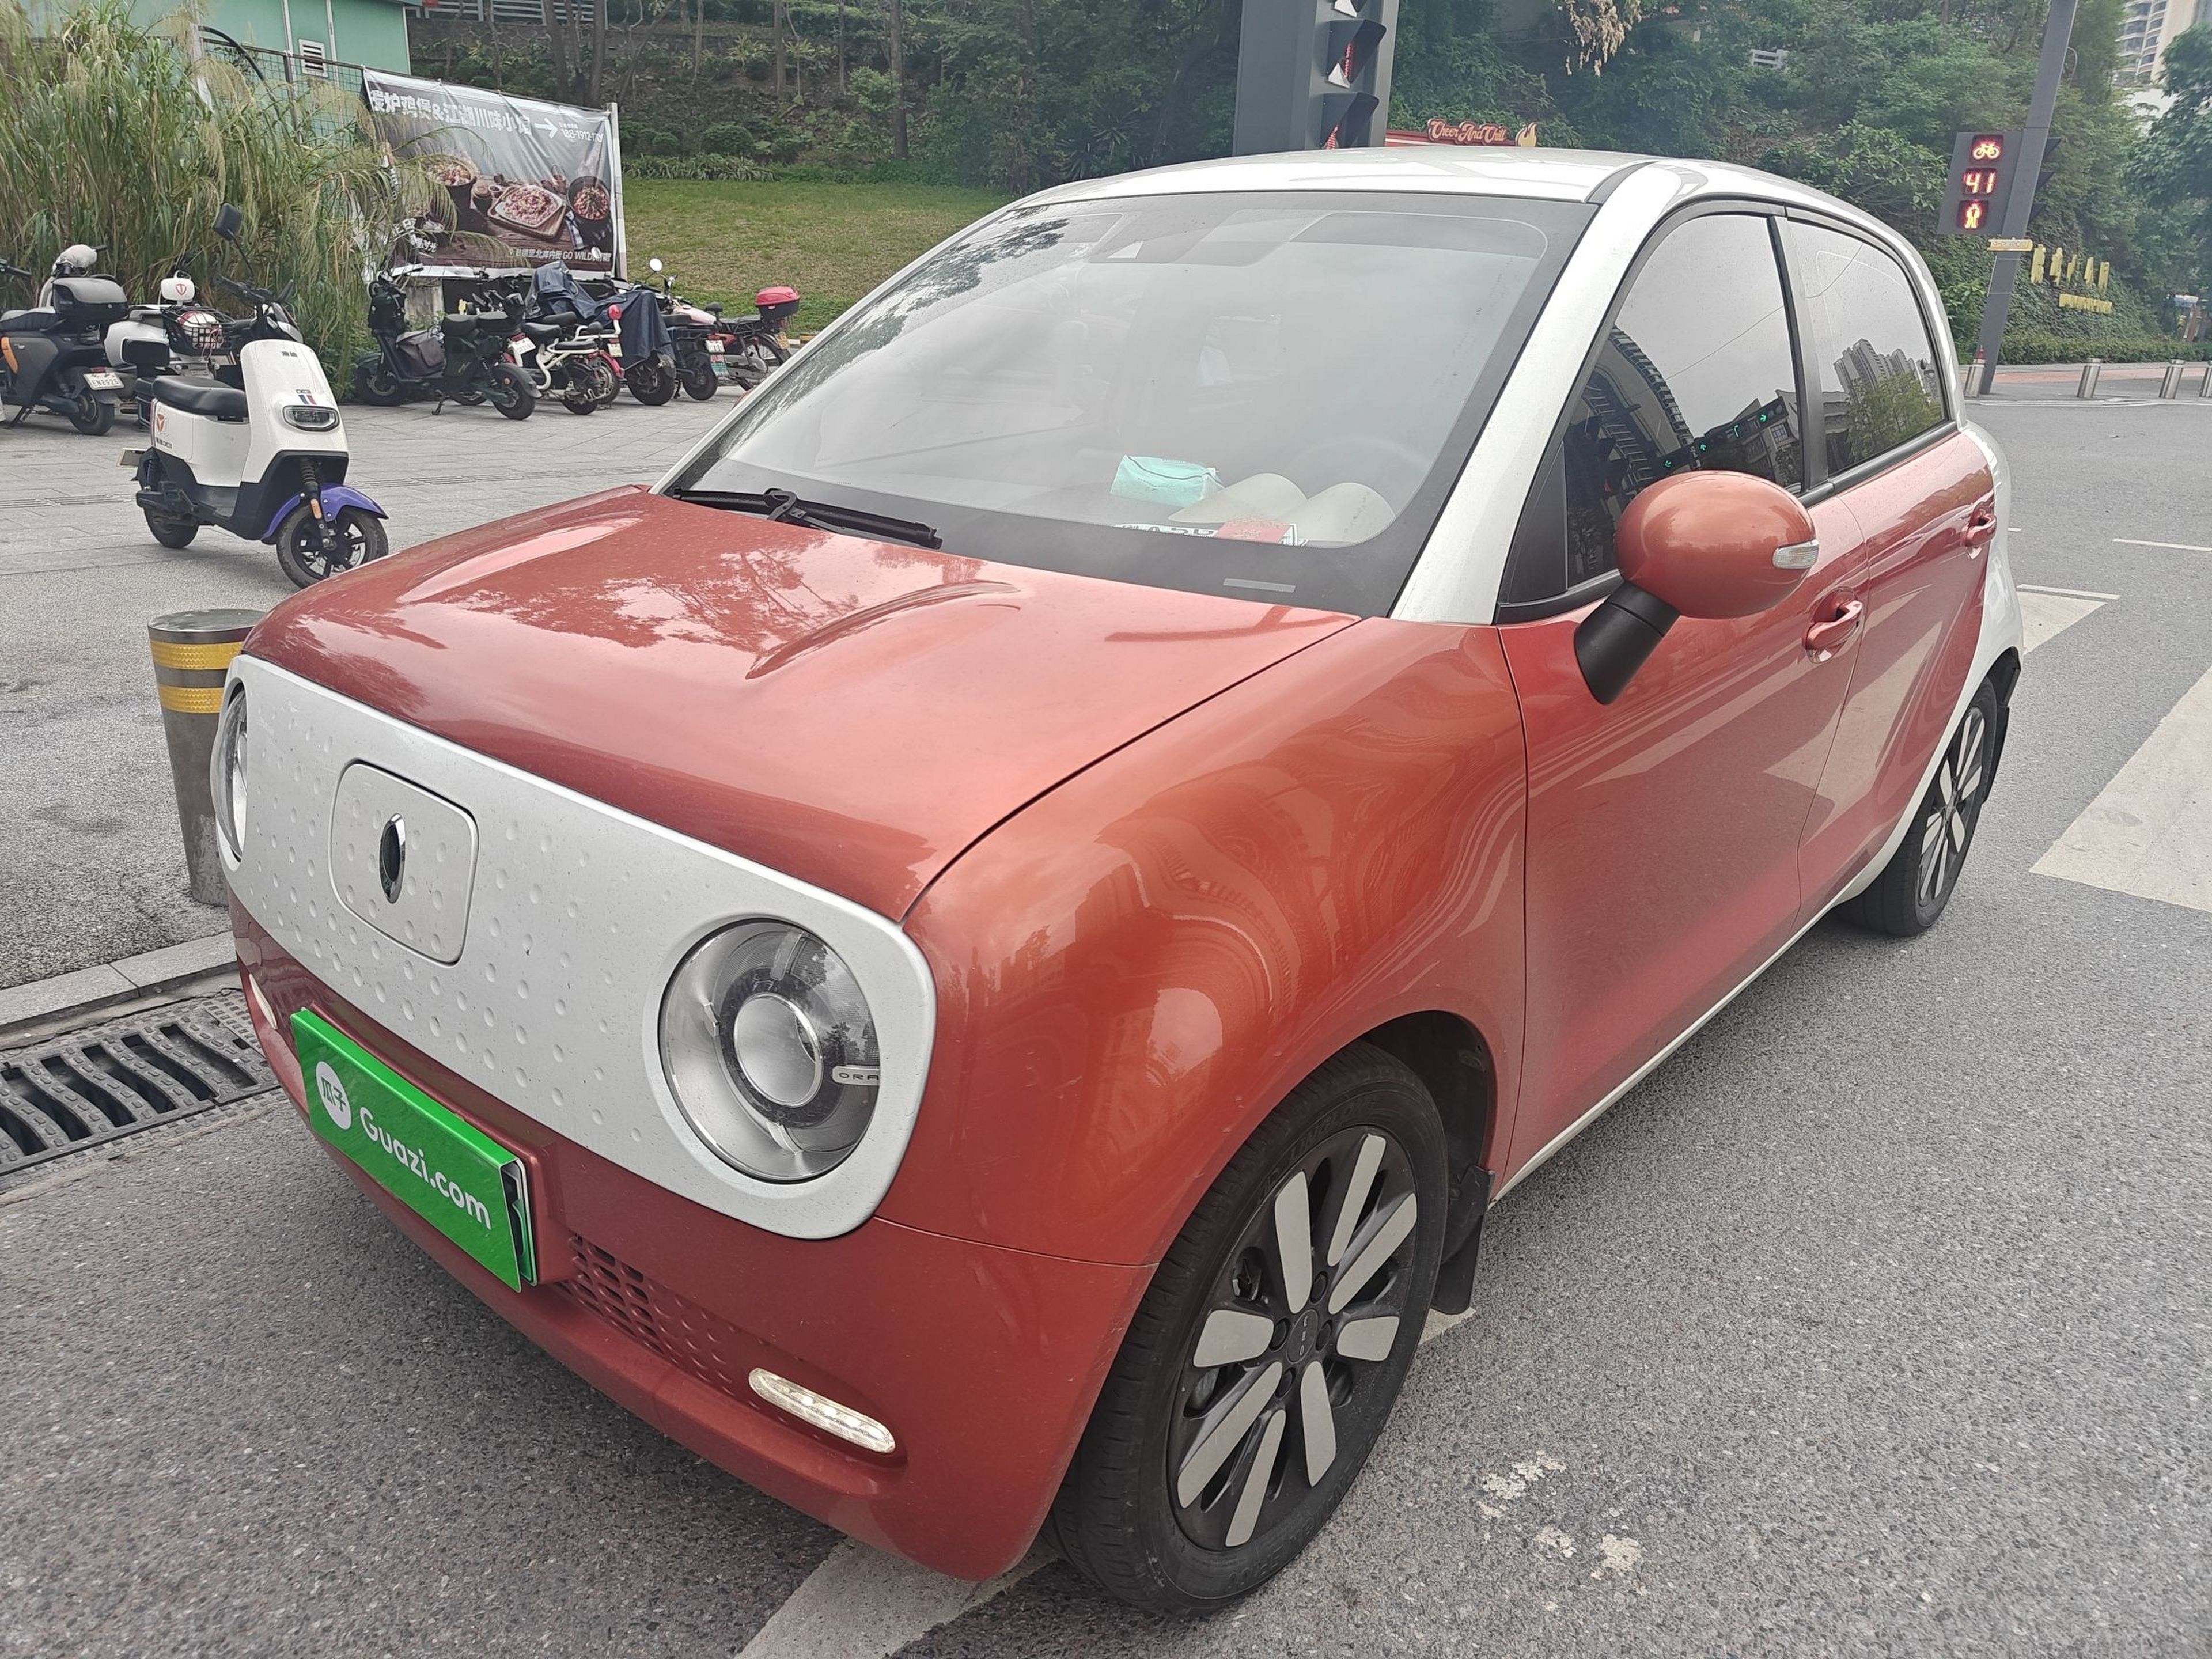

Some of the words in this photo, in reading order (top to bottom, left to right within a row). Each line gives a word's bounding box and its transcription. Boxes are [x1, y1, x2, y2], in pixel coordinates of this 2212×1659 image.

[1459, 123, 1483, 142] And
[1964, 172, 1997, 194] 41
[839, 1073, 880, 1081] ORA
[320, 1075, 346, 1113] 瓜子
[359, 1106, 493, 1231] Guazi.com
